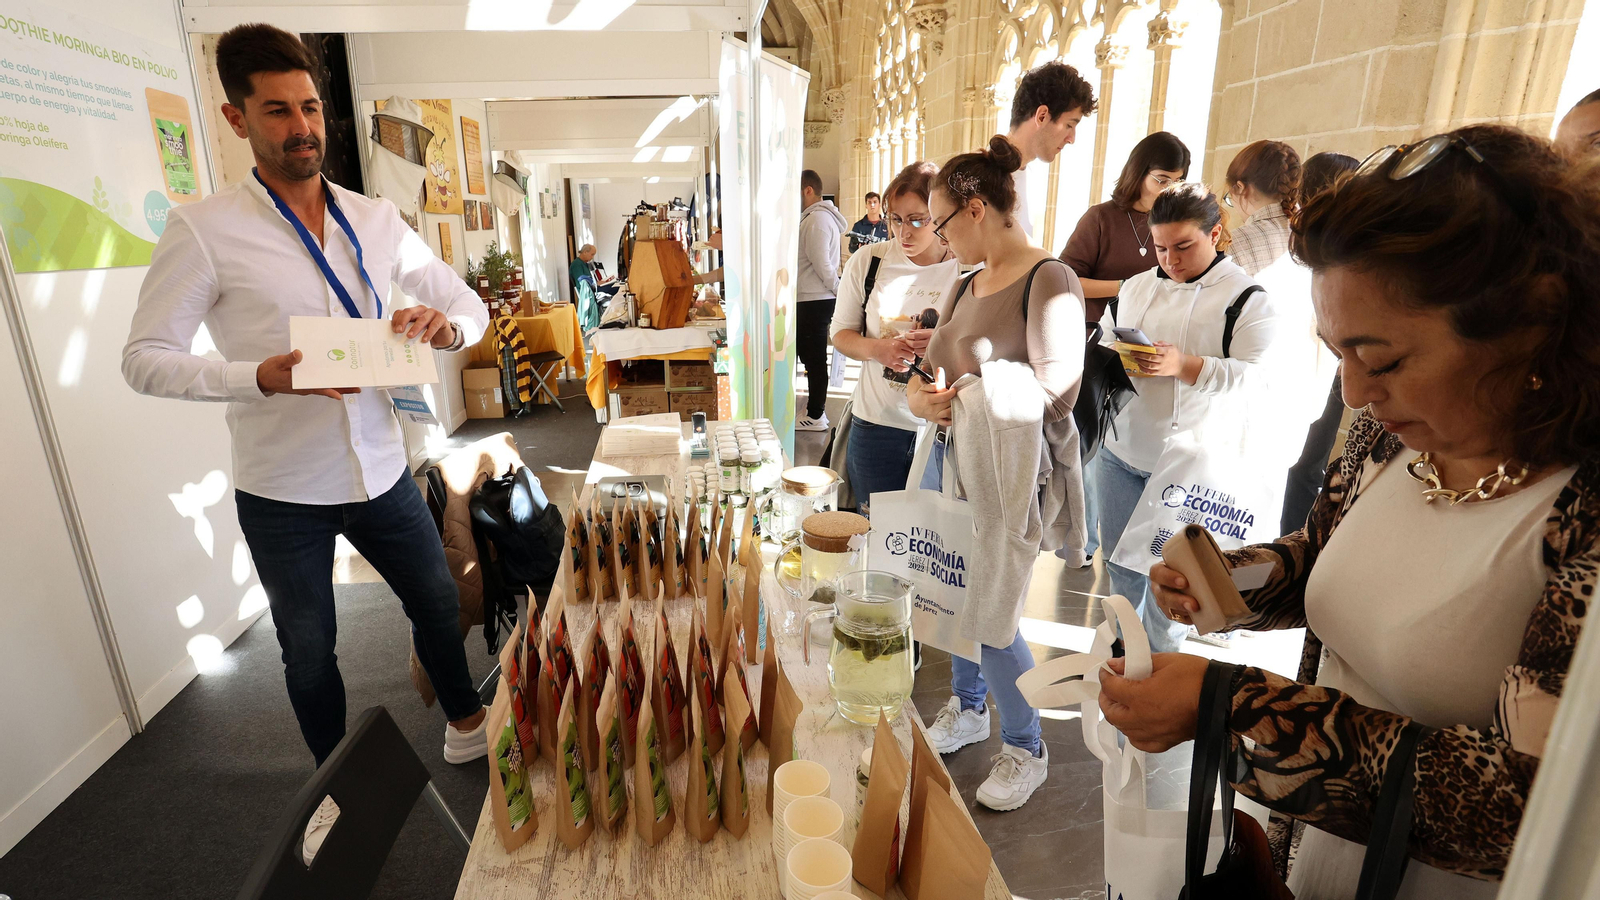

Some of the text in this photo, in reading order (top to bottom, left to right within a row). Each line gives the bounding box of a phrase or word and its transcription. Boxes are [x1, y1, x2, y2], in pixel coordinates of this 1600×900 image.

[52, 31, 111, 61] MORINGA
[111, 49, 130, 67] BIO
[131, 56, 146, 71] EN
[147, 61, 178, 80] POLVO
[1, 58, 14, 70] de
[16, 64, 40, 77] color
[41, 70, 48, 81] y
[80, 77, 93, 90] tus
[94, 83, 132, 99] smoothies
[24, 79, 34, 90] al
[35, 82, 65, 97] mismo
[66, 88, 96, 104] tiempo
[96, 97, 111, 108] que
[112, 98, 134, 112] llenas
[29, 95, 41, 106] de
[77, 106, 82, 117] y
[14, 118, 36, 133] hoja
[37, 122, 50, 133] de
[32, 135, 69, 150] Oleifera
[1190, 484, 1236, 505] IV FERIA
[1177, 508, 1199, 521] JEREZ
[1182, 494, 1255, 527] ECONOMÍA
[911, 526, 945, 549] IV FERIA
[1203, 517, 1248, 541] SOCIAL
[908, 538, 966, 571] ECONOMÍA
[908, 554, 926, 566] JEREZ
[907, 561, 925, 573] 2022
[930, 561, 966, 588] SOCIAL
[914, 593, 955, 616] Ayuntamiento
[914, 601, 938, 616] de Jerez
